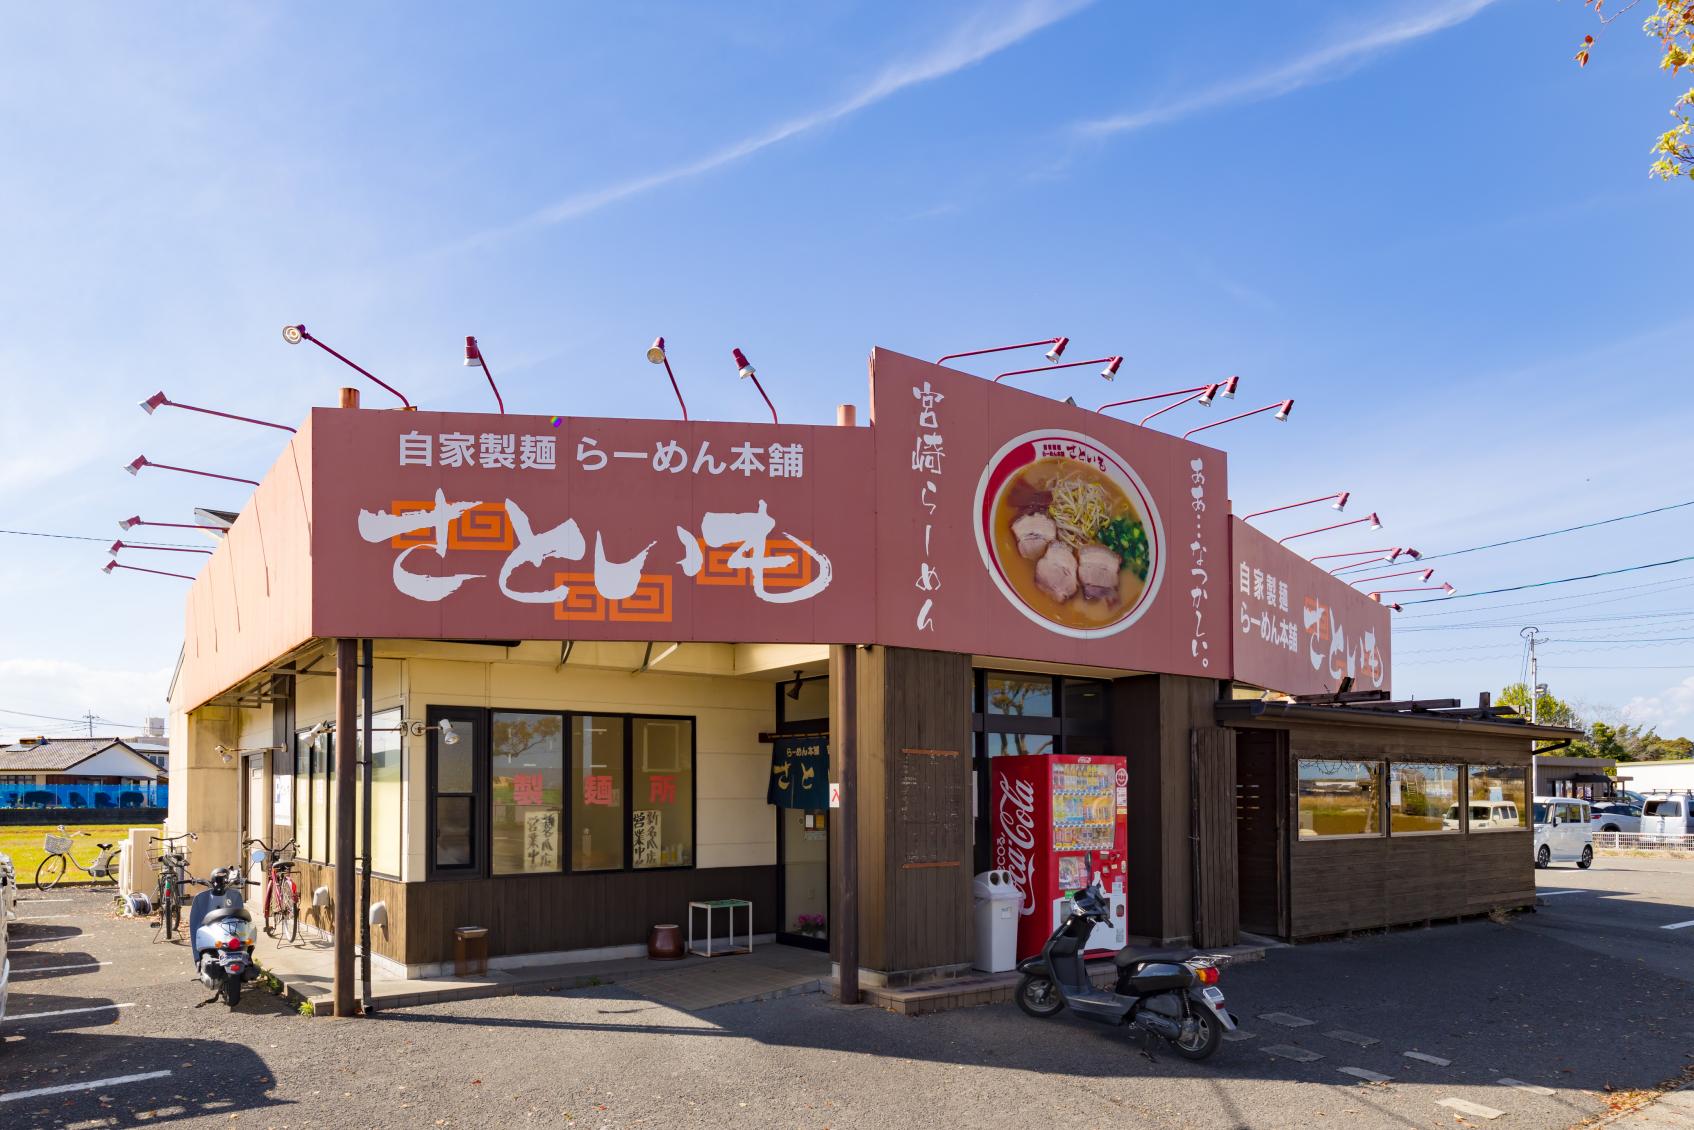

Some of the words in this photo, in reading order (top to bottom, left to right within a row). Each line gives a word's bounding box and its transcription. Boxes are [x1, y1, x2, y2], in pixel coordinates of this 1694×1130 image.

[399, 431, 557, 470] 自家製麺
[576, 437, 804, 478] らーめん本舗
[358, 488, 832, 603] さといも
[1239, 561, 1289, 613] 自家製麺
[1240, 601, 1298, 653] らーめん本舗
[1303, 597, 1384, 688] さといも
